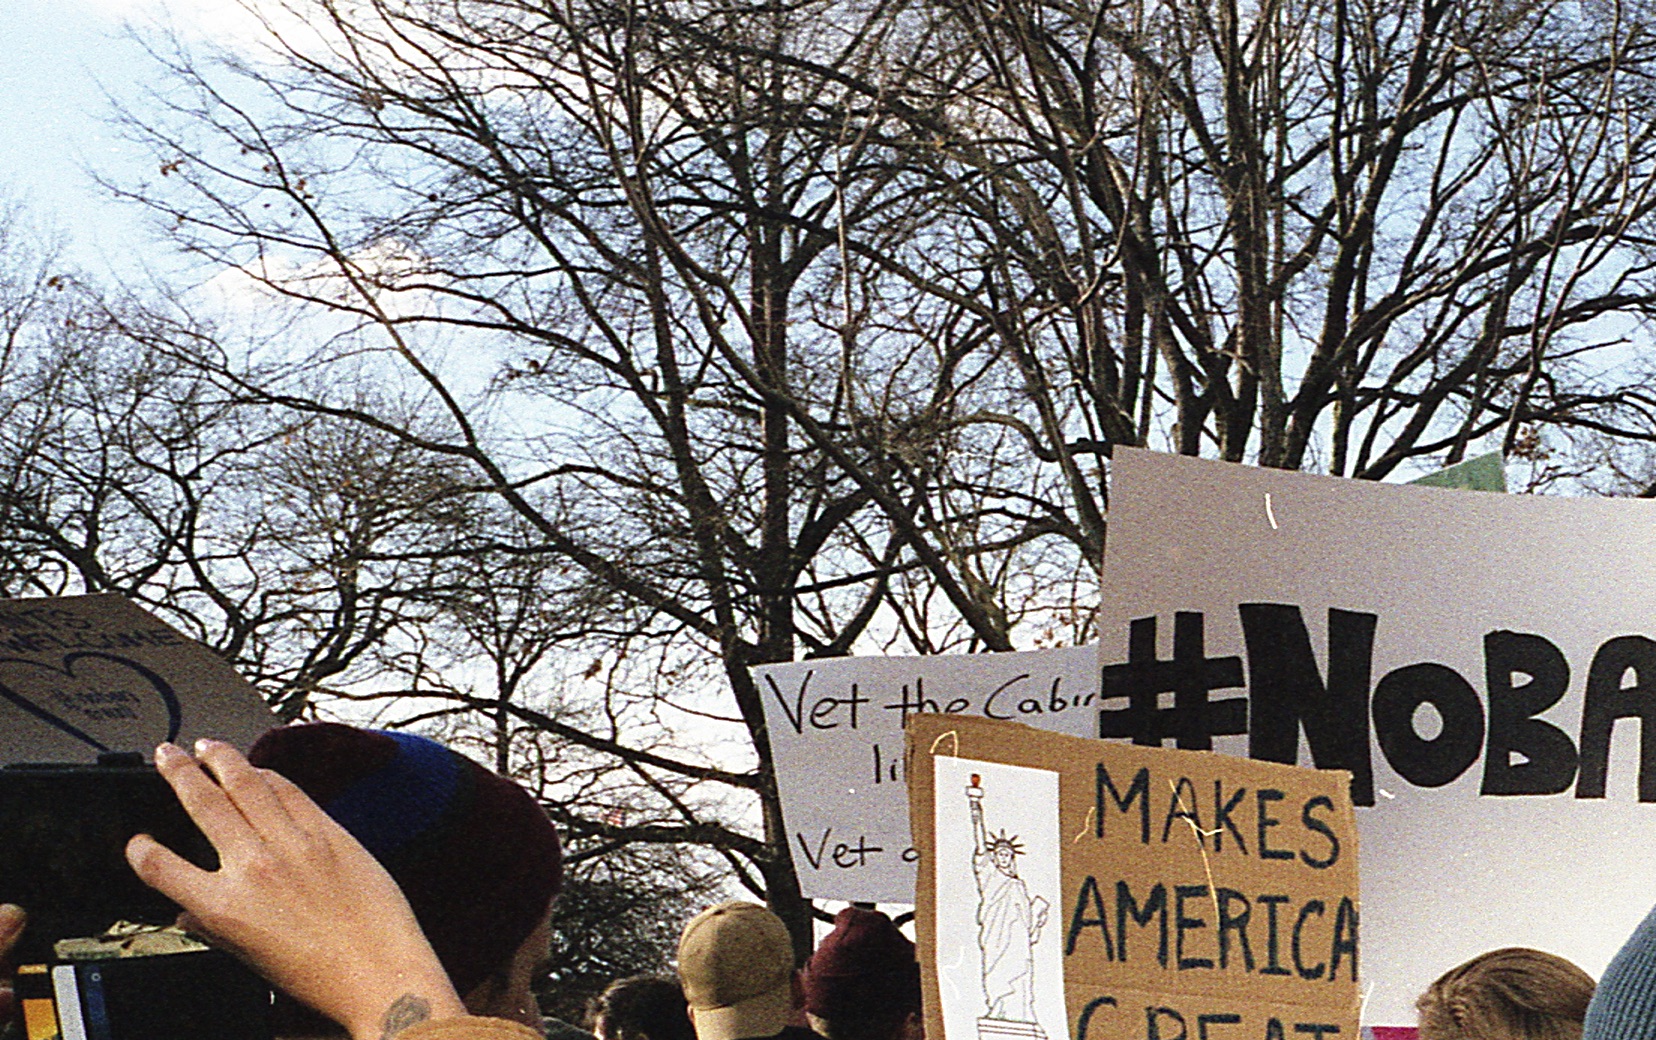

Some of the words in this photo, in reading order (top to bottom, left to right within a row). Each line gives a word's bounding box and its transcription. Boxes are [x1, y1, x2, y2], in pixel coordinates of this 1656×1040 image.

[765, 670, 870, 733] Vet
[885, 677, 971, 729] the
[797, 828, 883, 870] Vet
[1096, 762, 1340, 869] MAKES
[1066, 875, 1360, 982] AMERICA
